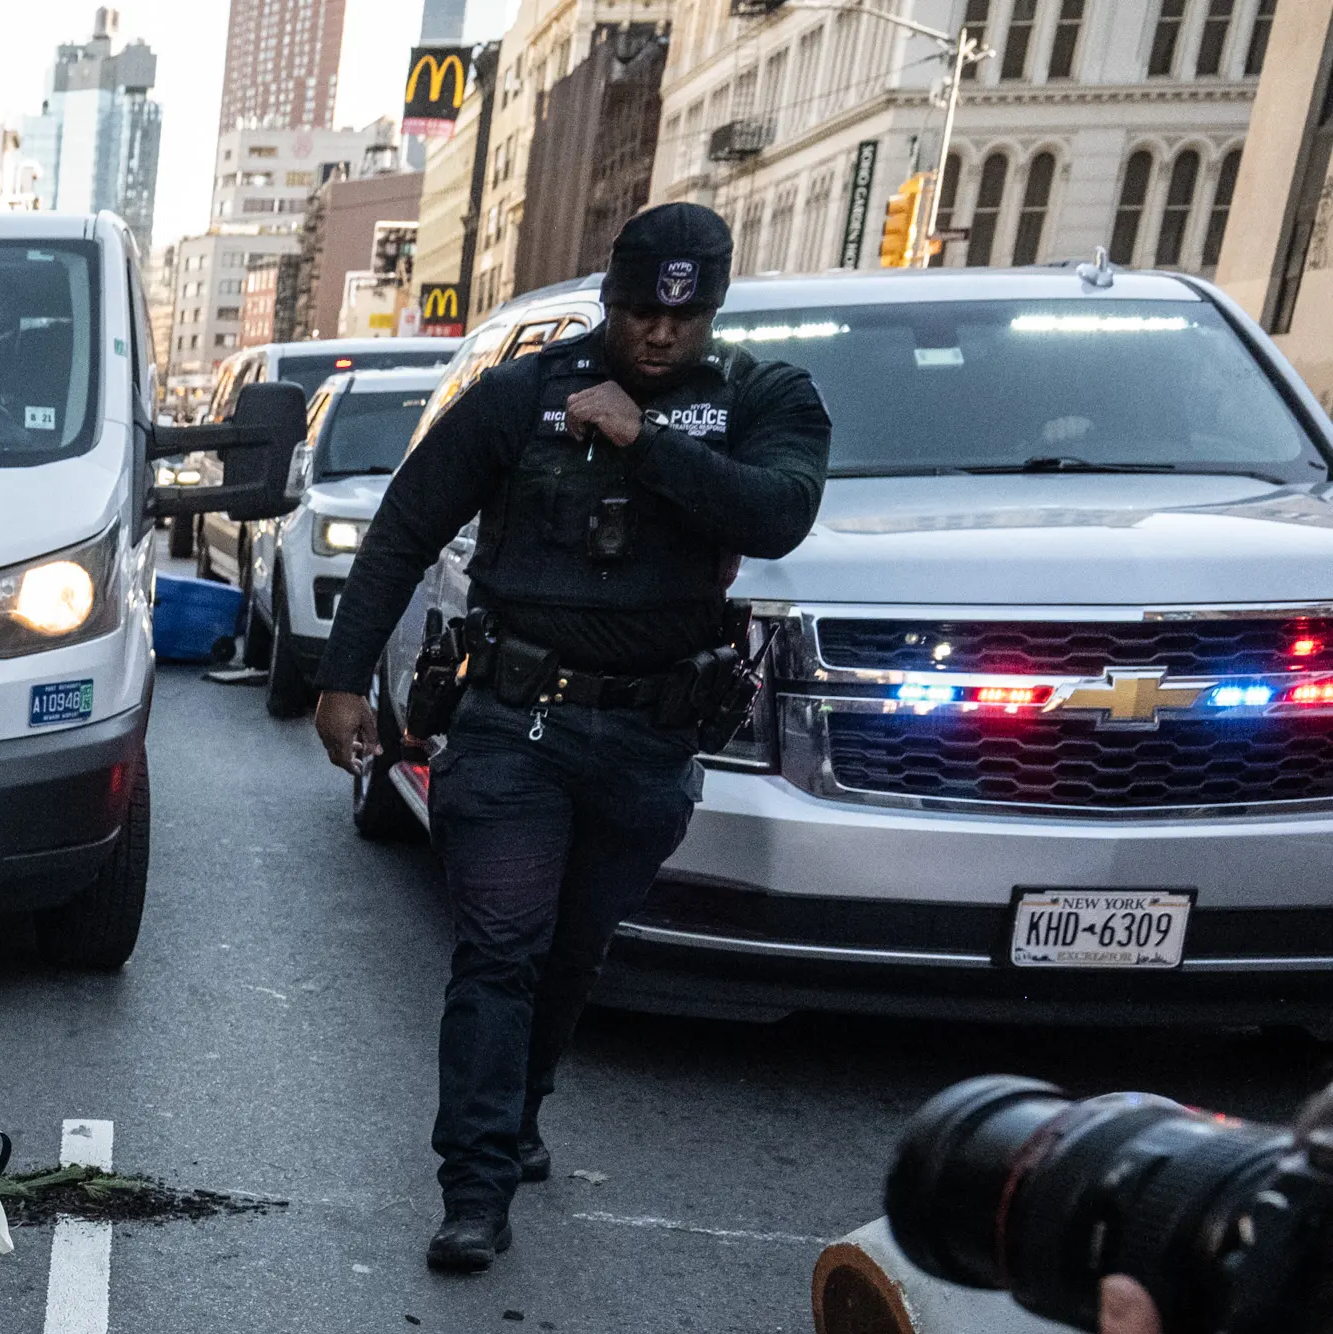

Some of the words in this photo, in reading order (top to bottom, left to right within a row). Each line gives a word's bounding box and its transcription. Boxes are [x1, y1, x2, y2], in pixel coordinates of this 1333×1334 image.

[668, 261, 693, 273] NYPD
[577, 360, 590, 368] S1
[671, 409, 728, 426] POLICE
[1062, 898, 1100, 910] NEW
[1105, 898, 1148, 910] YORK
[1056, 951, 1134, 962] EXCELSIOR
